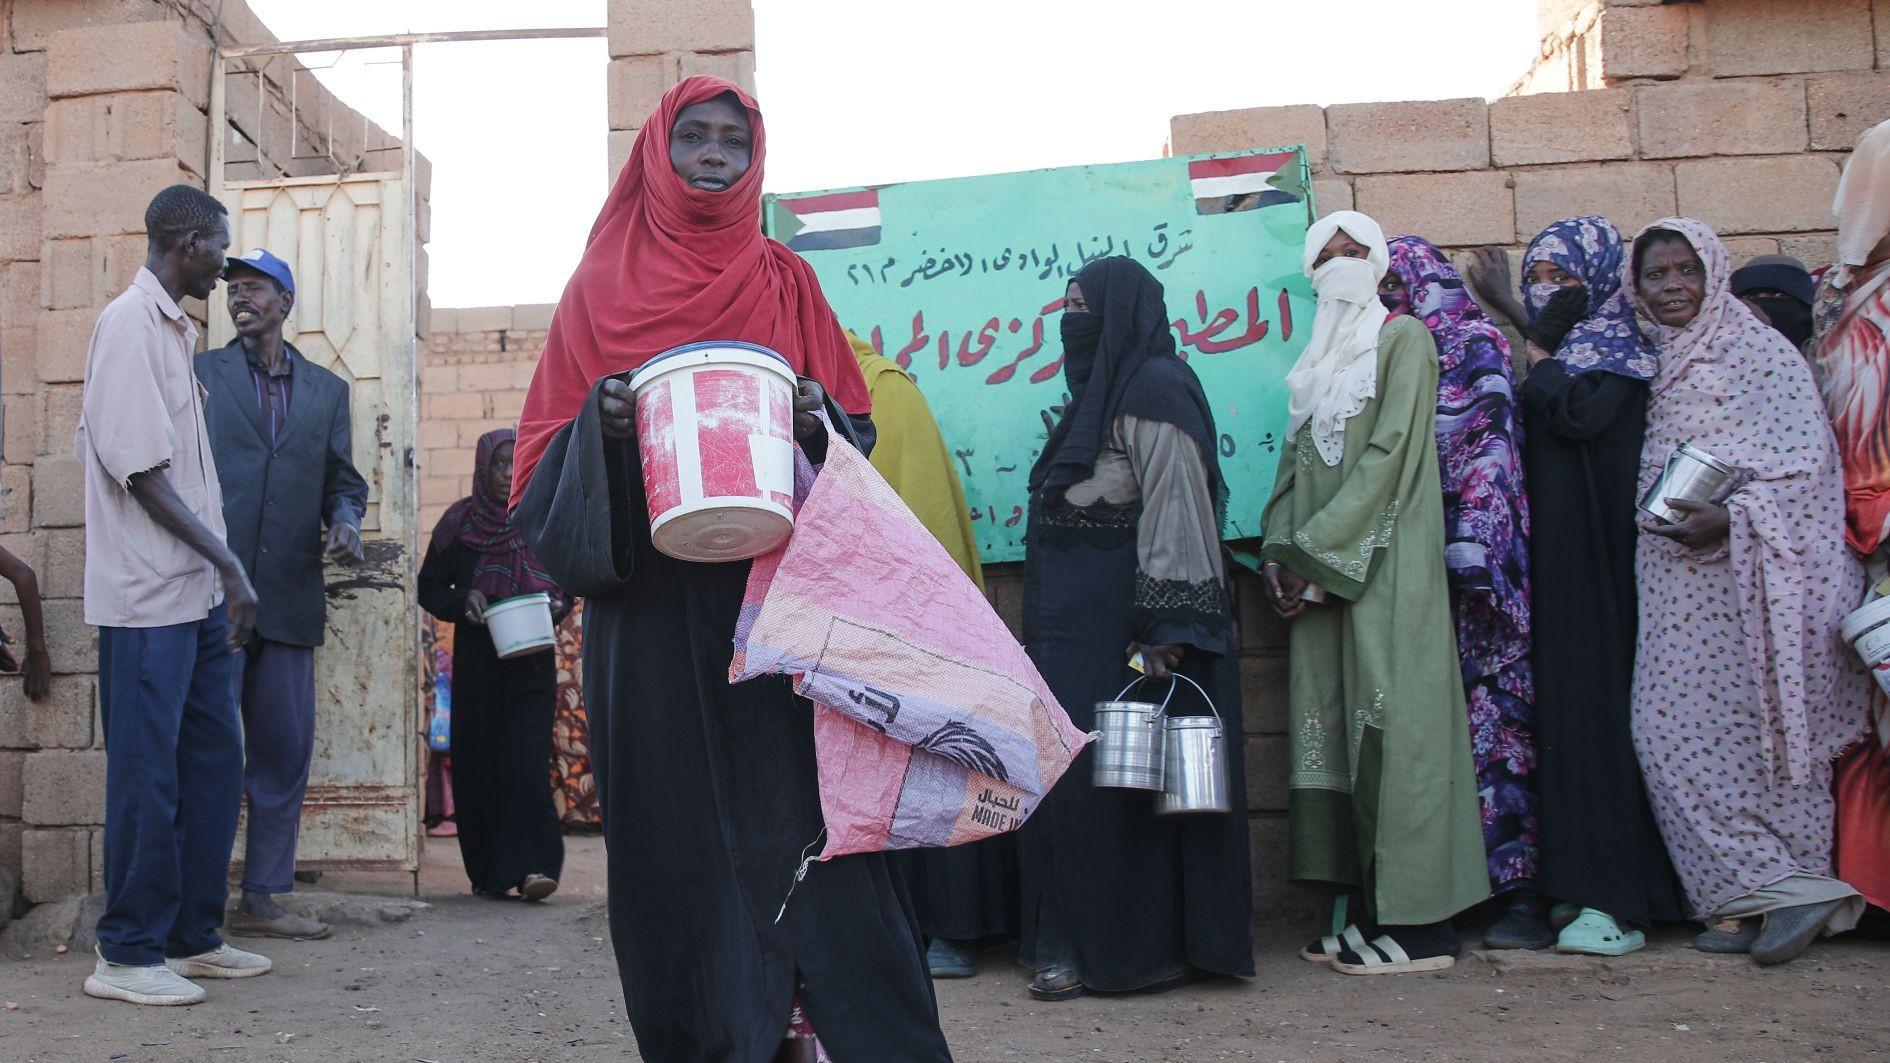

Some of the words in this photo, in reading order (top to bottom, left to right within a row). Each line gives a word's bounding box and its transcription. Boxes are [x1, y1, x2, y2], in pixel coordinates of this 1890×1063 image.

[1147, 222, 1194, 270] شرق
[1168, 286, 1294, 362] المطب
[970, 803, 1007, 832] MADE
